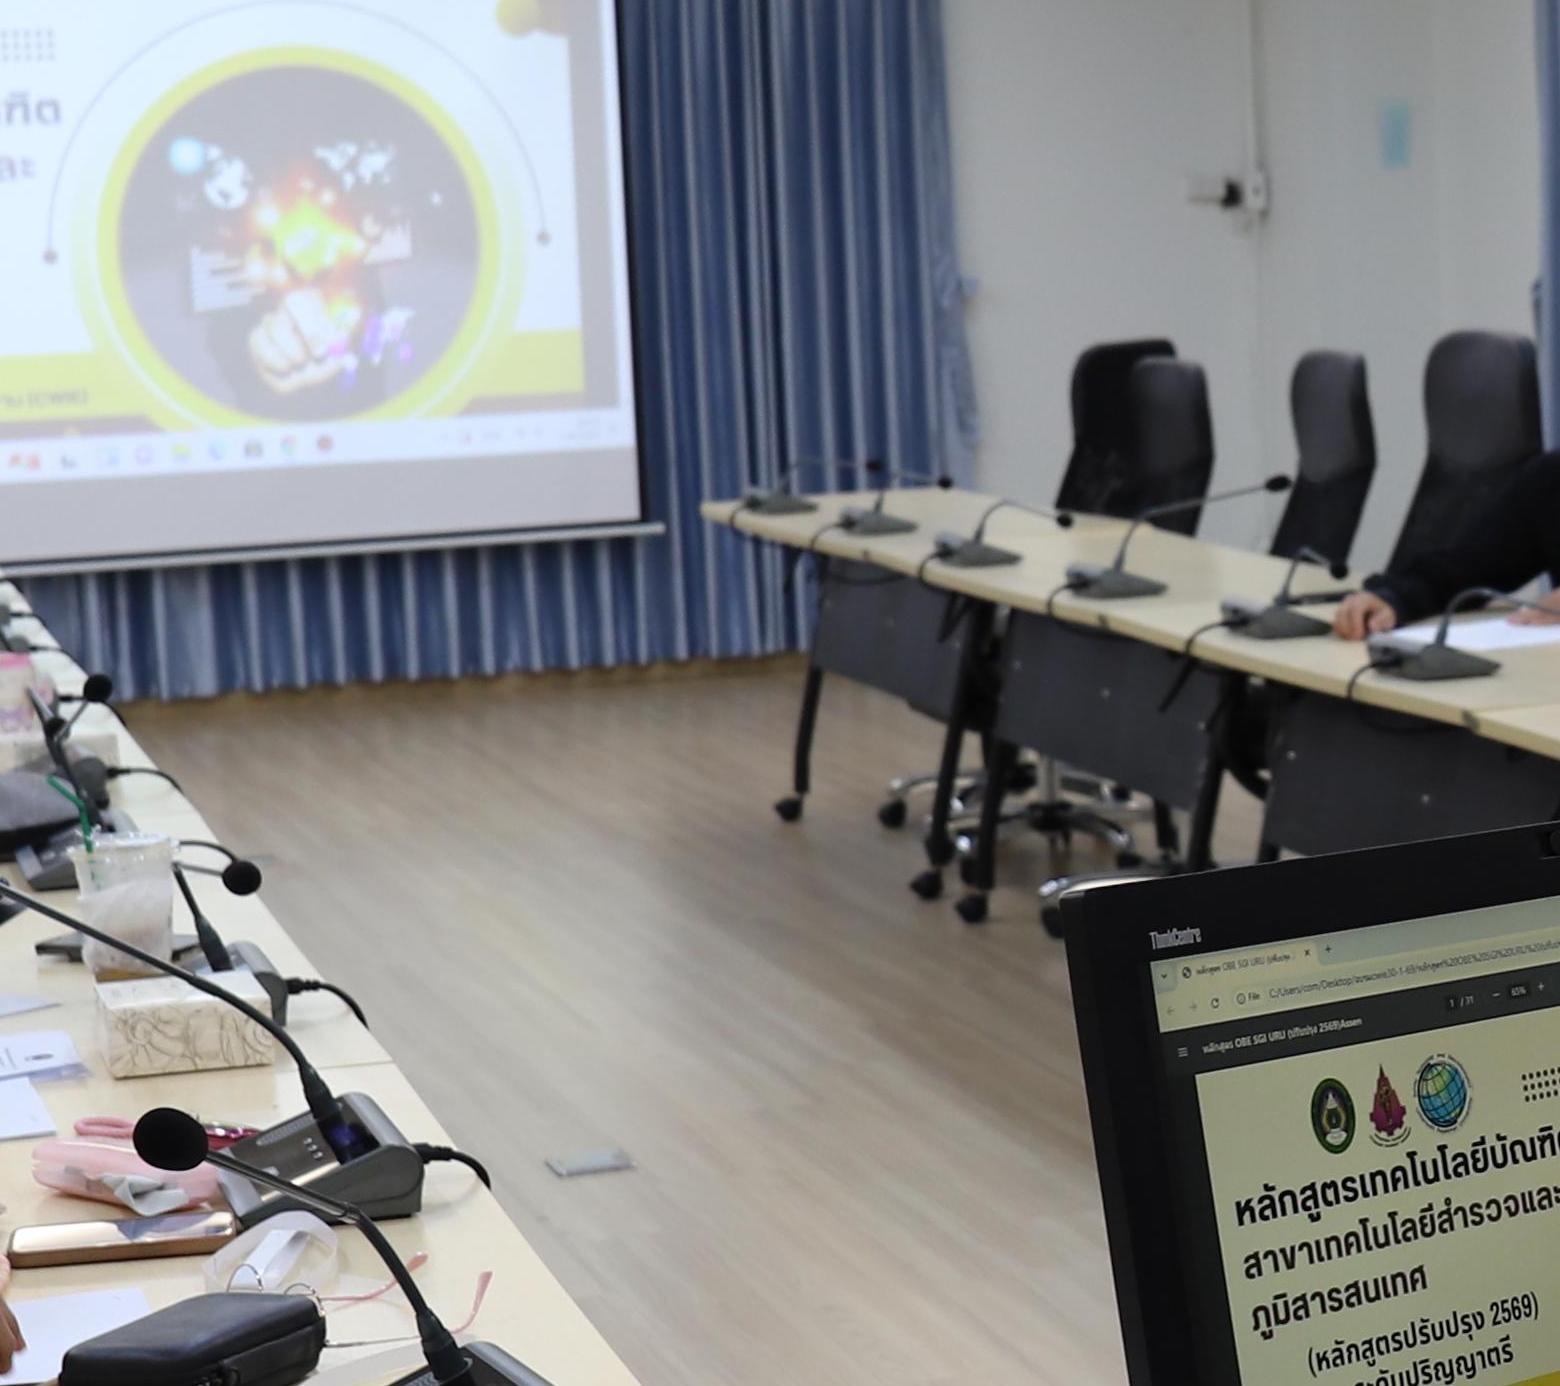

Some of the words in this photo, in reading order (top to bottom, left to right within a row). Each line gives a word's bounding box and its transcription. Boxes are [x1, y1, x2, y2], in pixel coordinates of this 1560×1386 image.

[1251, 1264, 1428, 1342] ภูมิสารสนเทศ
[1307, 1308, 1486, 1379] (หลักสูตรปรับปรุง
[1489, 1291, 1540, 1330] 2569)
